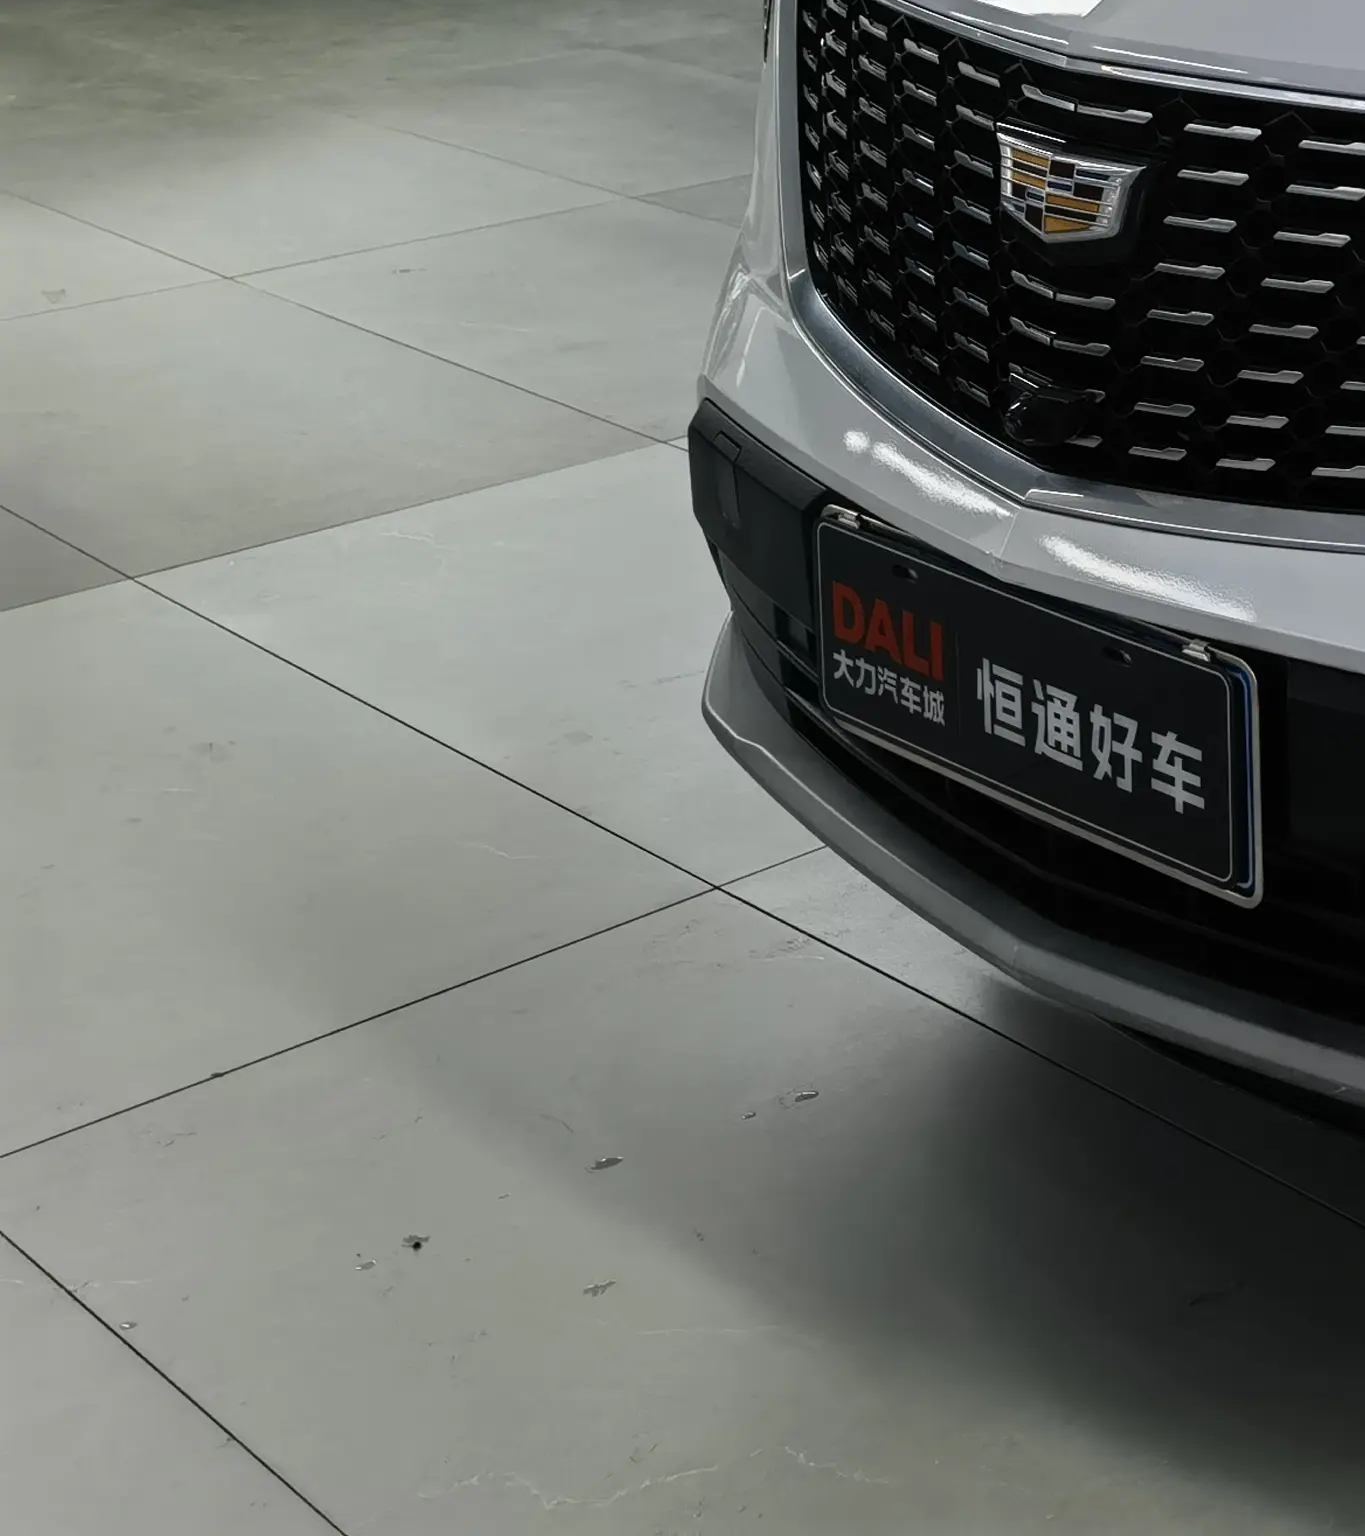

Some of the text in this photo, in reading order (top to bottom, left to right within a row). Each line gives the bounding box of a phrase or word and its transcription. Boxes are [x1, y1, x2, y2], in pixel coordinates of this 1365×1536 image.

[832, 580, 944, 682] DALI
[832, 648, 946, 727] 大力汽车城
[976, 657, 1205, 814] 恒通好车
